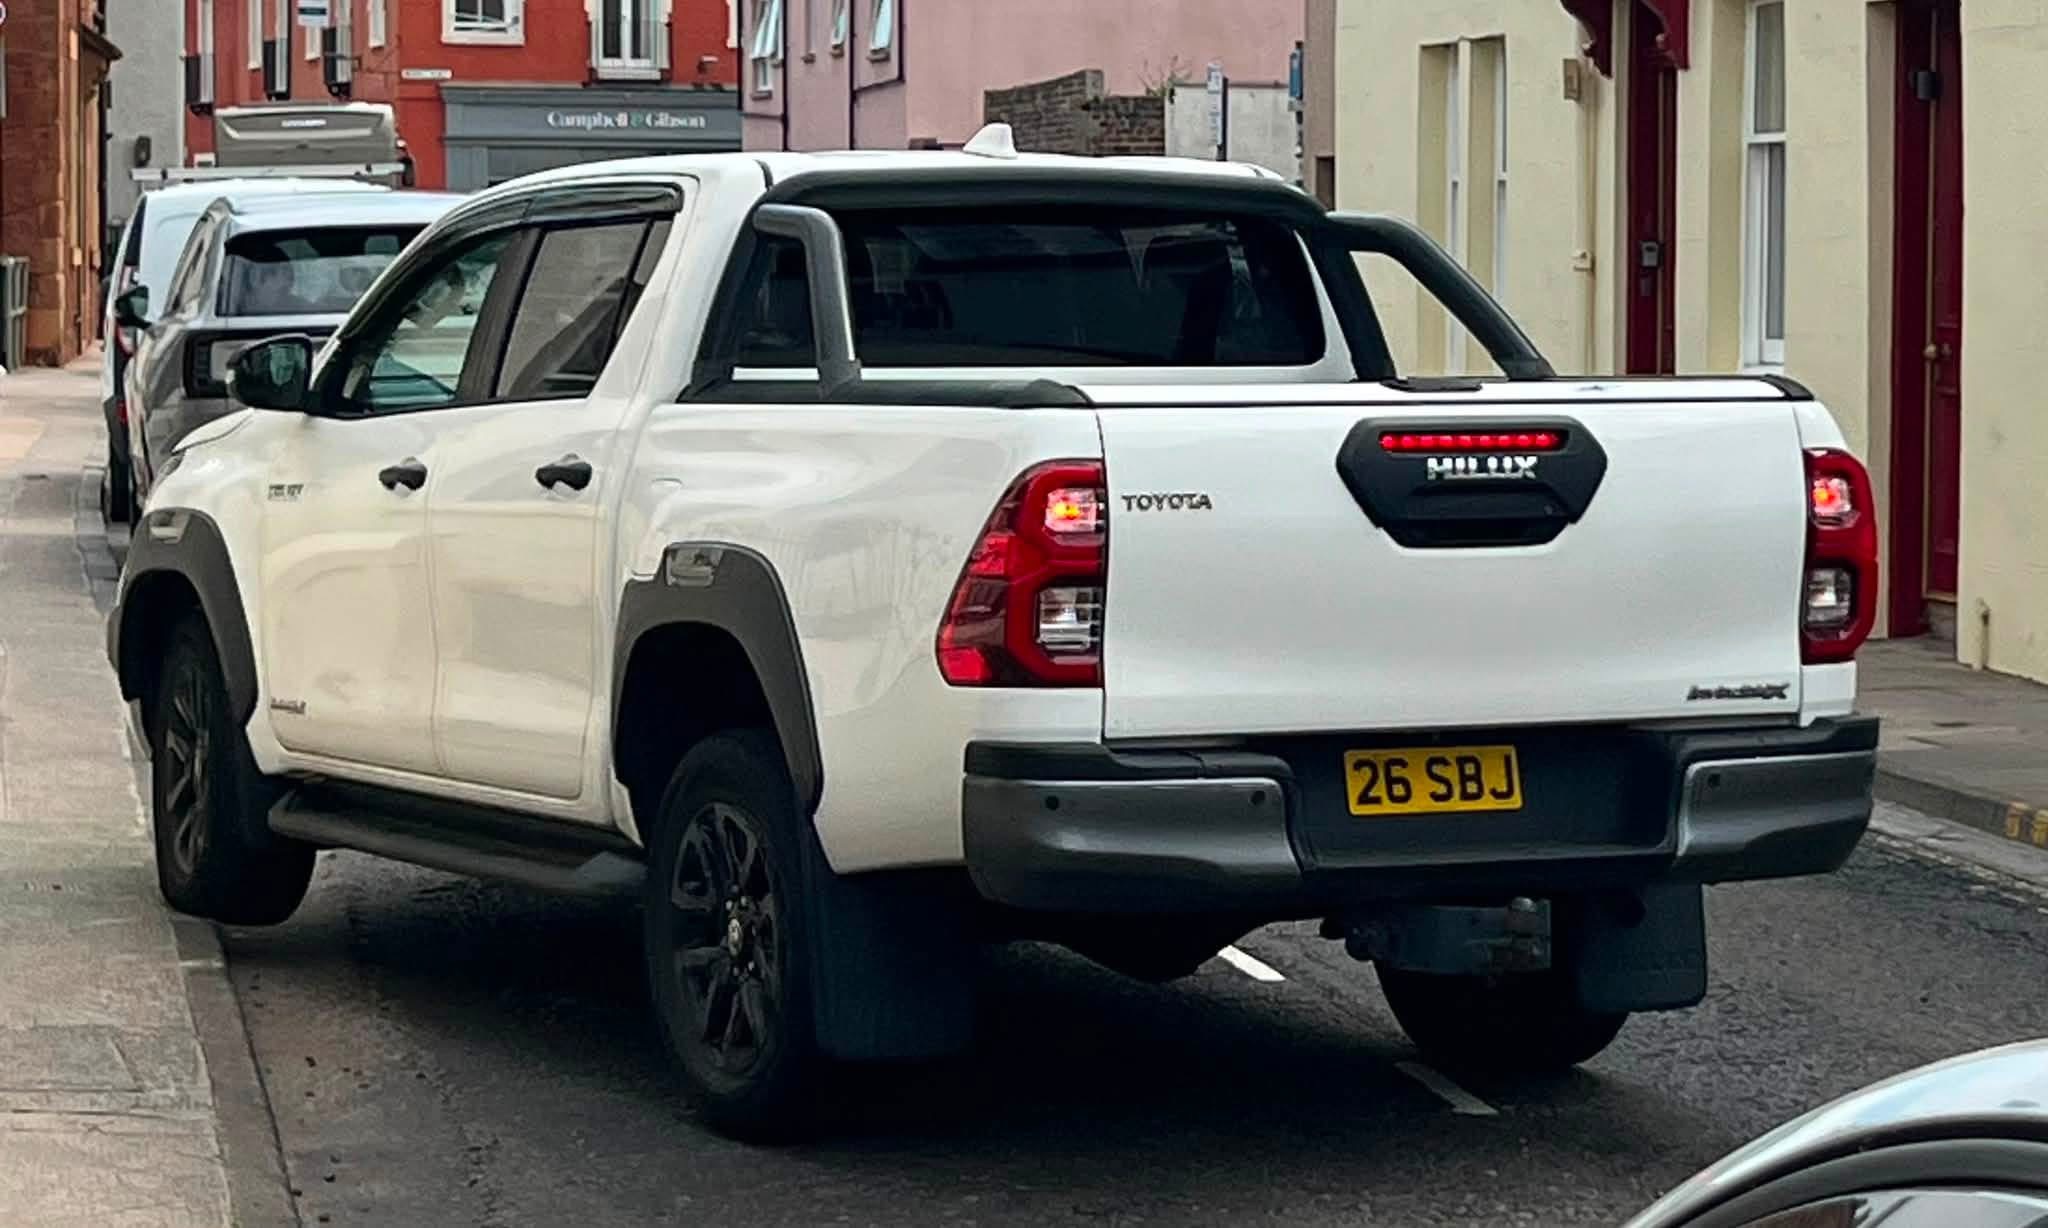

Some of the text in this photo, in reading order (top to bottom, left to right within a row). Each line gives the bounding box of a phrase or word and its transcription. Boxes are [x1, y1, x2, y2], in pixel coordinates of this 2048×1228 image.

[547, 111, 628, 131] Campbell
[645, 112, 706, 129] Gibson
[1427, 456, 1537, 480] HILUX
[1121, 493, 1212, 512] TOYOTA
[1353, 754, 1514, 805] 26 SBJ
